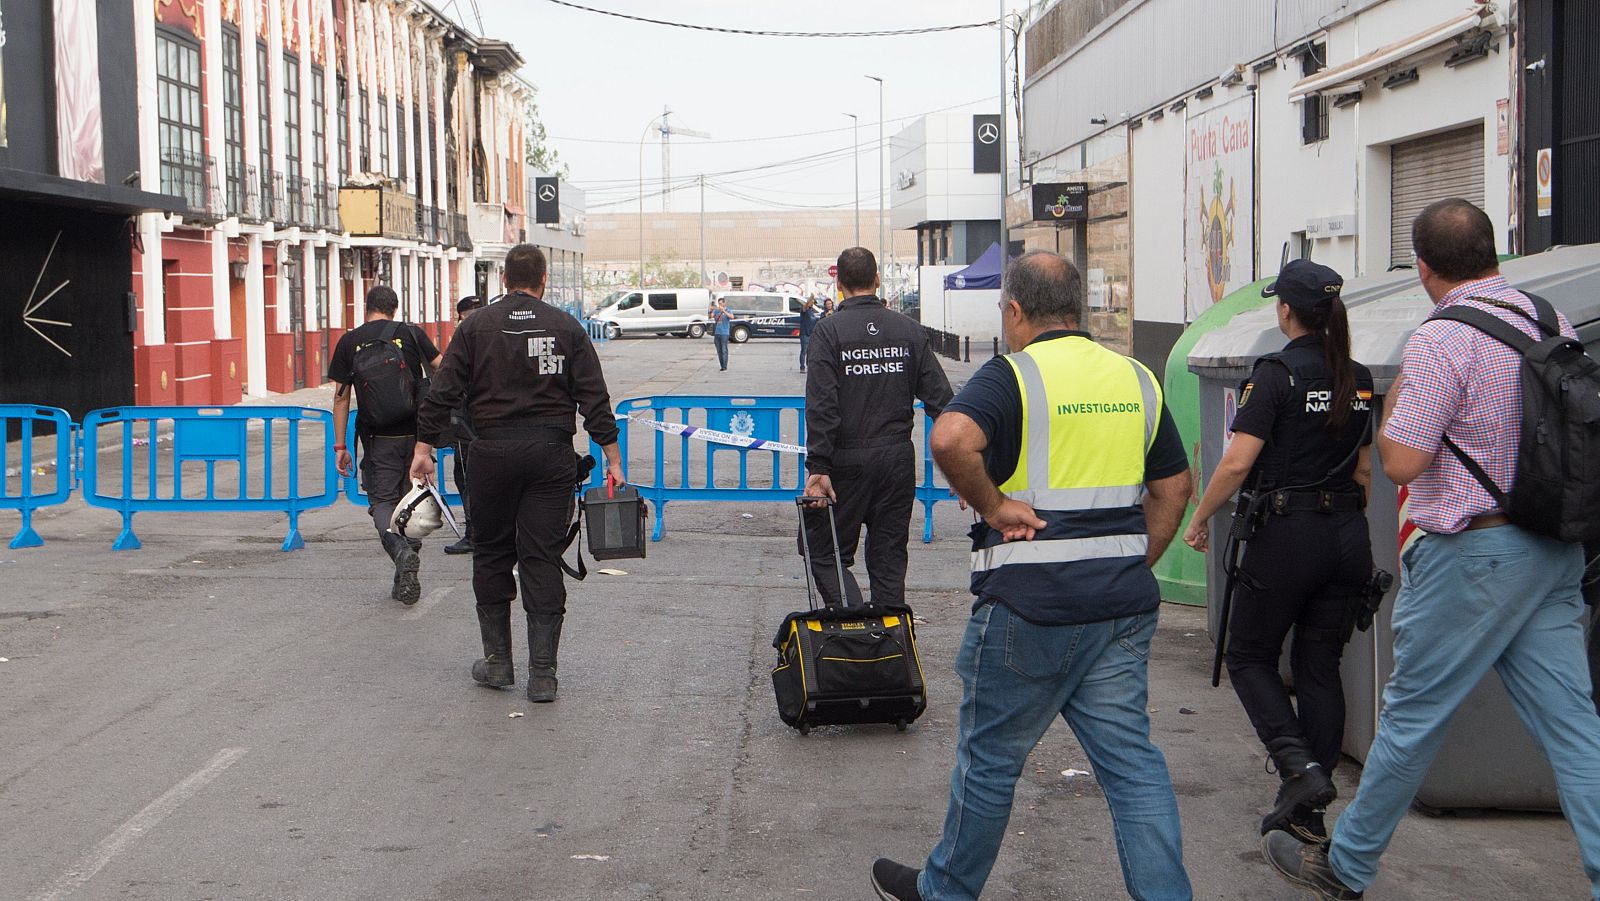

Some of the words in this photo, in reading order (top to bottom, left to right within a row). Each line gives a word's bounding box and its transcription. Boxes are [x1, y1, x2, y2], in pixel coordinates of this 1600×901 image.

[1191, 127, 1217, 164] Punta
[1222, 115, 1249, 154] Cana
[527, 336, 556, 357] HEF
[538, 354, 566, 375] EST
[844, 361, 904, 376] FORENSE
[1057, 402, 1141, 415] INVESTIGADOR
